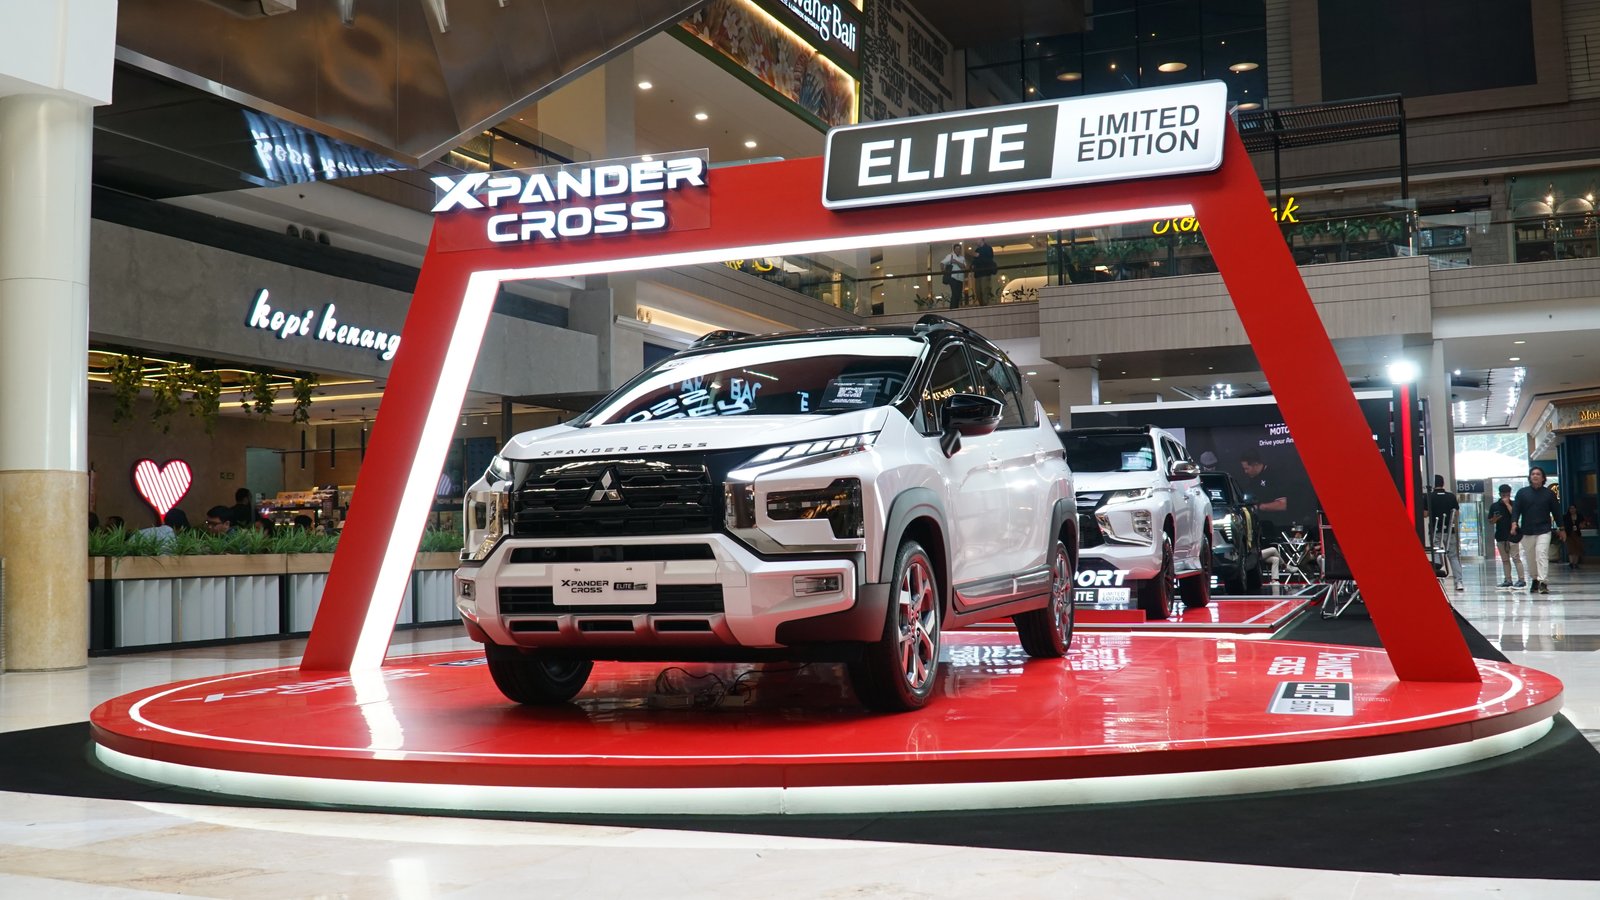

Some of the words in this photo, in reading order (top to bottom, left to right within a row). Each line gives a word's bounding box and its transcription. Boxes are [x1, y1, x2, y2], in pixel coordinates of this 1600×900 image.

[832, 4, 856, 52] Bali
[1079, 104, 1200, 138] LIMITED
[857, 123, 1028, 187] ELITE
[1076, 128, 1200, 163] EDITION
[430, 156, 706, 213] XPANDER
[486, 199, 667, 243] CROSS
[248, 288, 315, 340] kopi
[316, 303, 402, 361] kenang
[541, 446, 629, 457] XPANDER
[638, 442, 708, 451] CROSS
[561, 579, 610, 587] XPANDER
[1074, 591, 1095, 602] ITE
